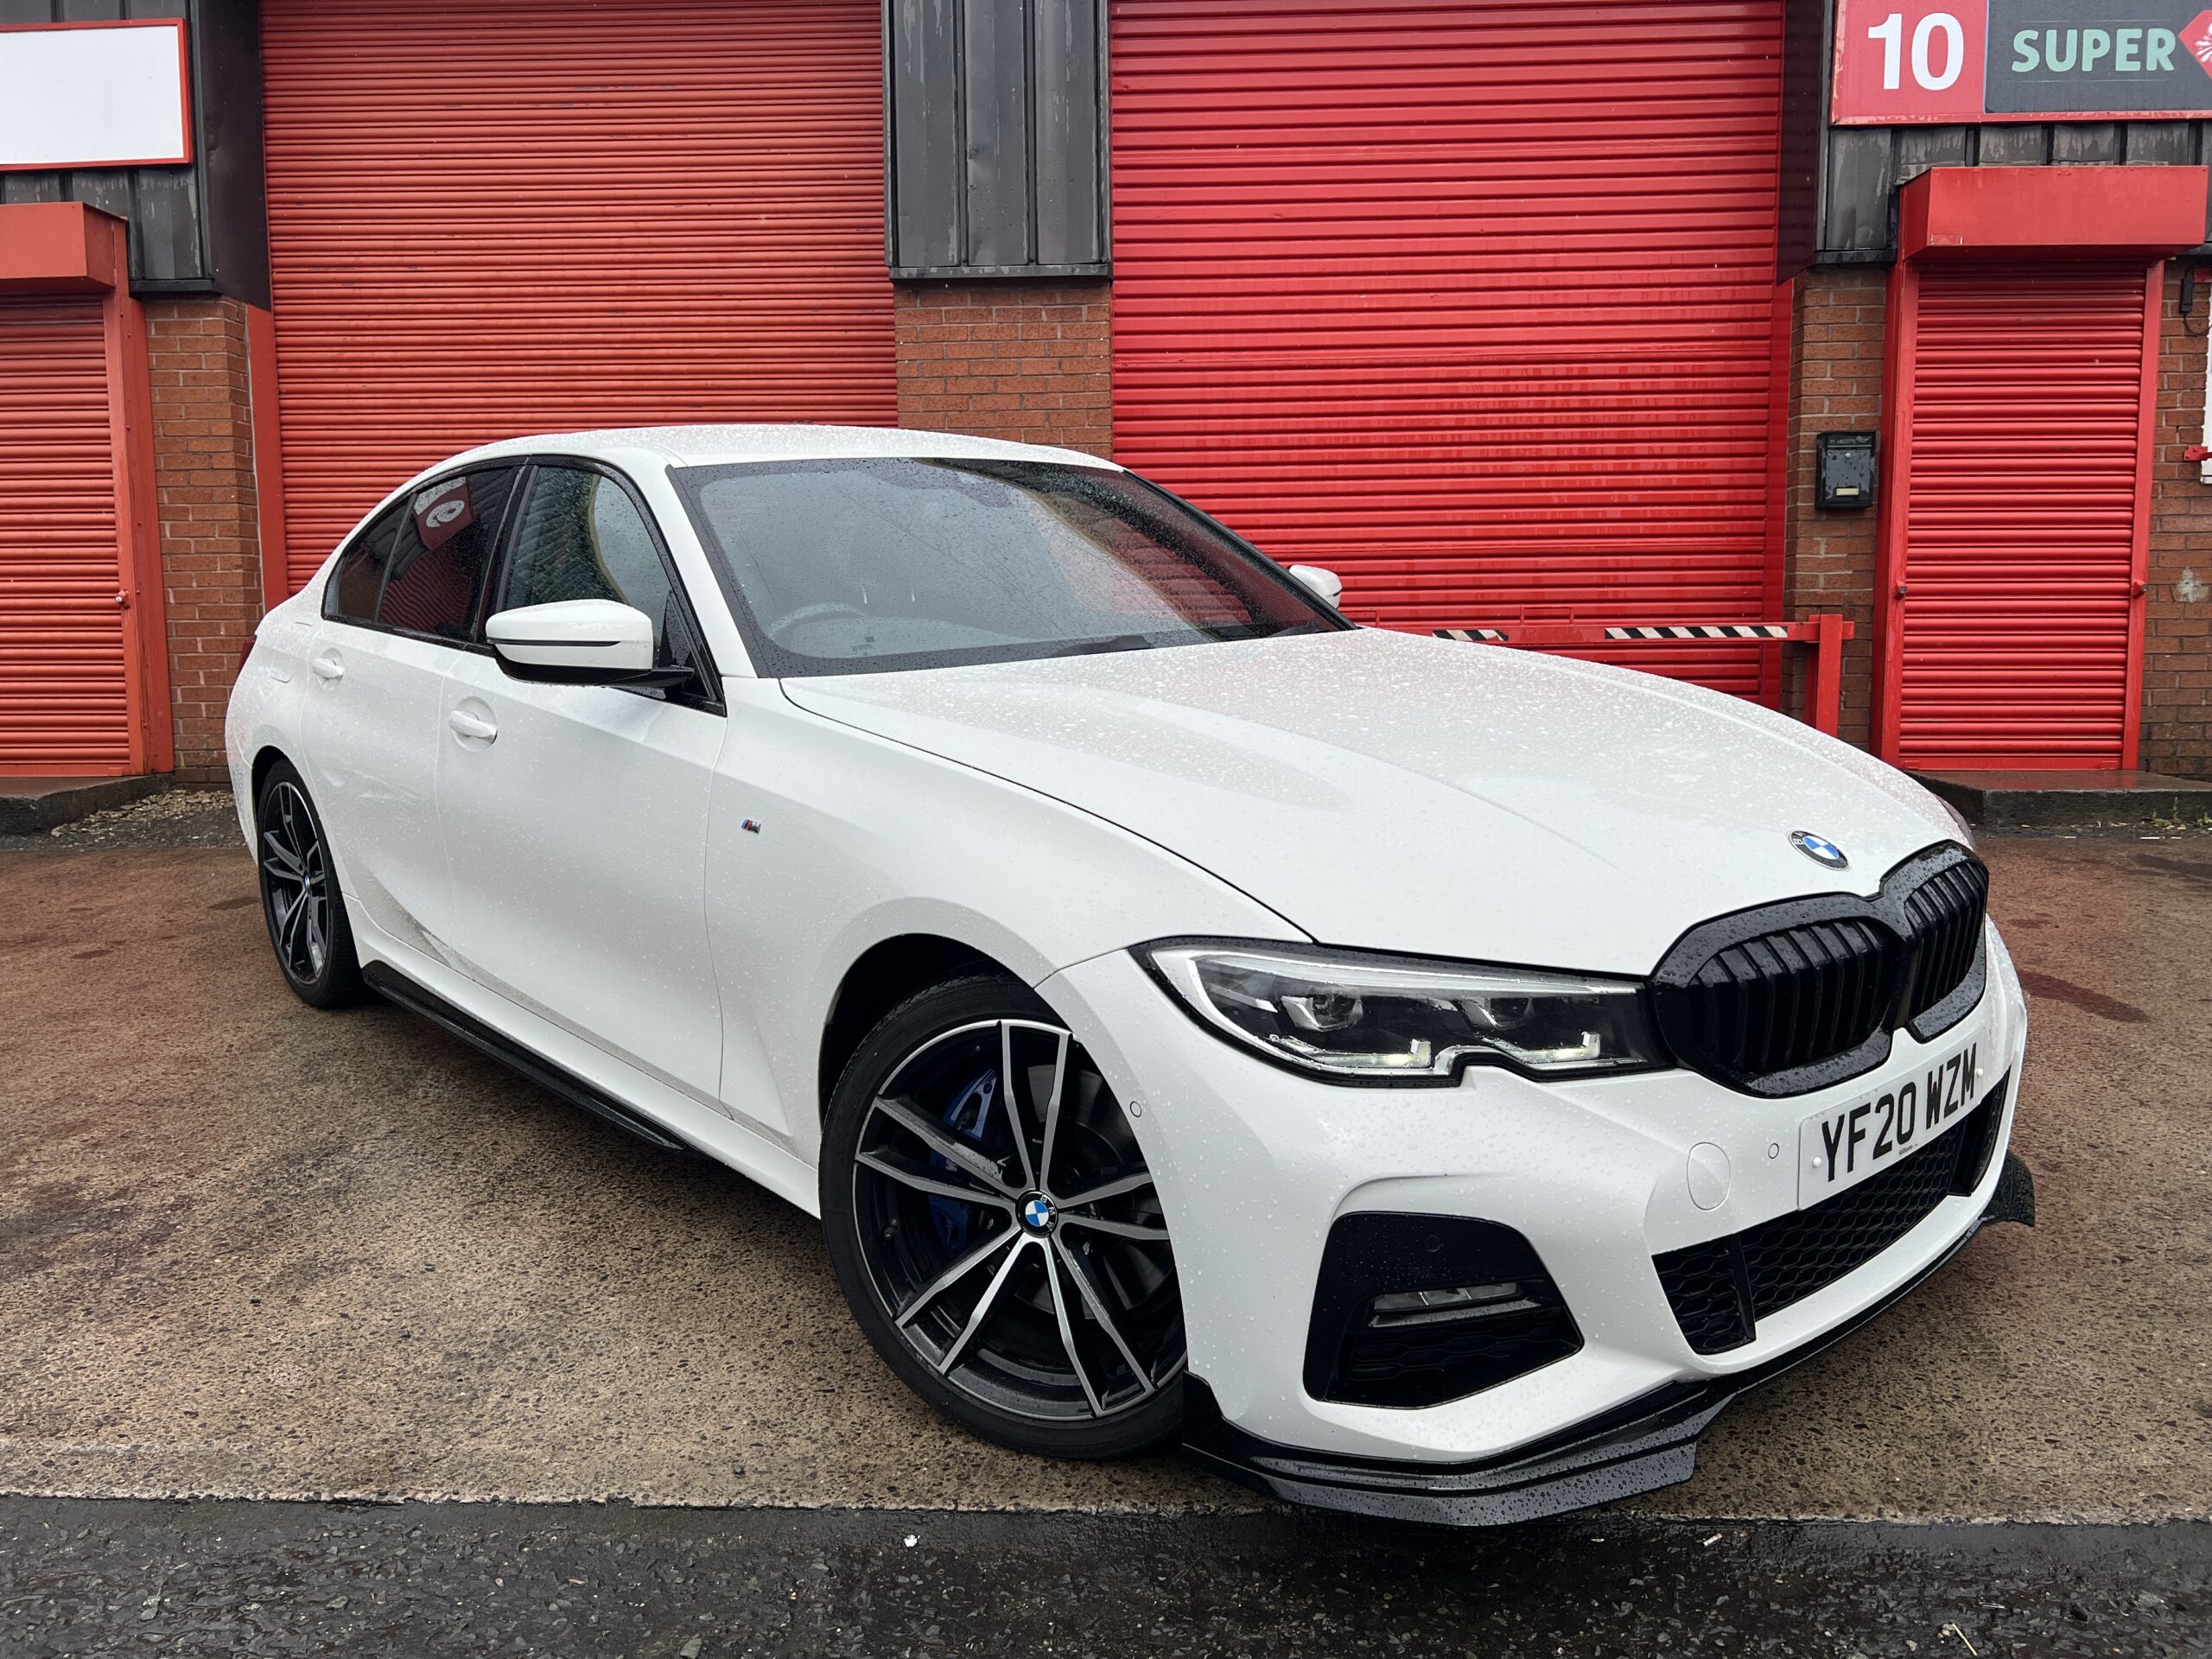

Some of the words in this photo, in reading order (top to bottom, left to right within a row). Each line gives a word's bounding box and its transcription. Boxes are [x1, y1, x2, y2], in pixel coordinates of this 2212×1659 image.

[1867, 12, 1965, 91] 10
[2012, 28, 2177, 73] SUPER
[1821, 1082, 1916, 1183] YF20
[1925, 1042, 1977, 1131] WZM
